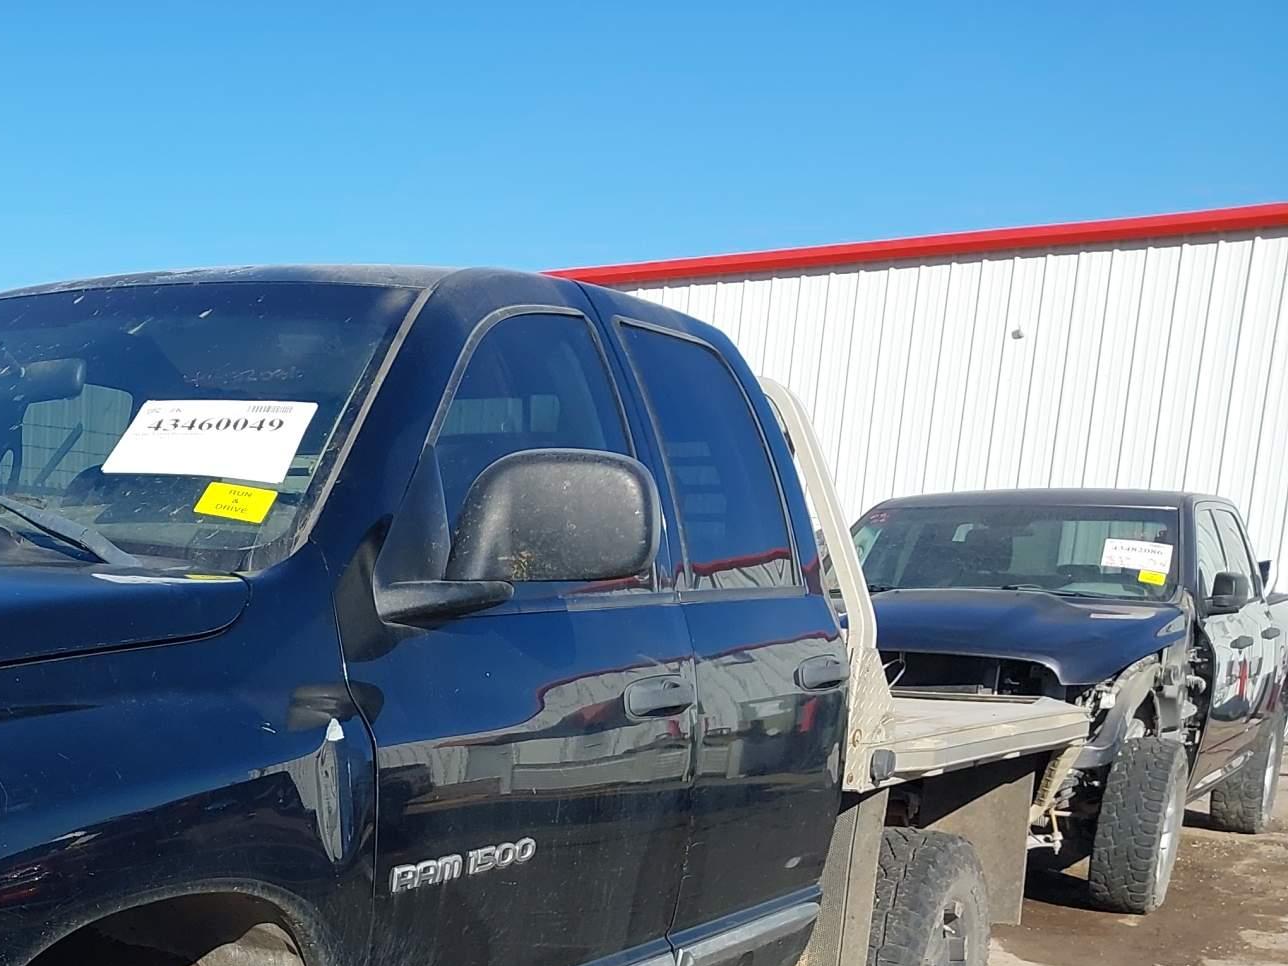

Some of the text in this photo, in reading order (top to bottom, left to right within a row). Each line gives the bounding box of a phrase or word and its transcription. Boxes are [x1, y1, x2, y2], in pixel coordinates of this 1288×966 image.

[146, 417, 285, 432] 43460049
[227, 489, 253, 498] RUN
[214, 504, 249, 514] DRIVE
[390, 836, 537, 893] RAM 1500
